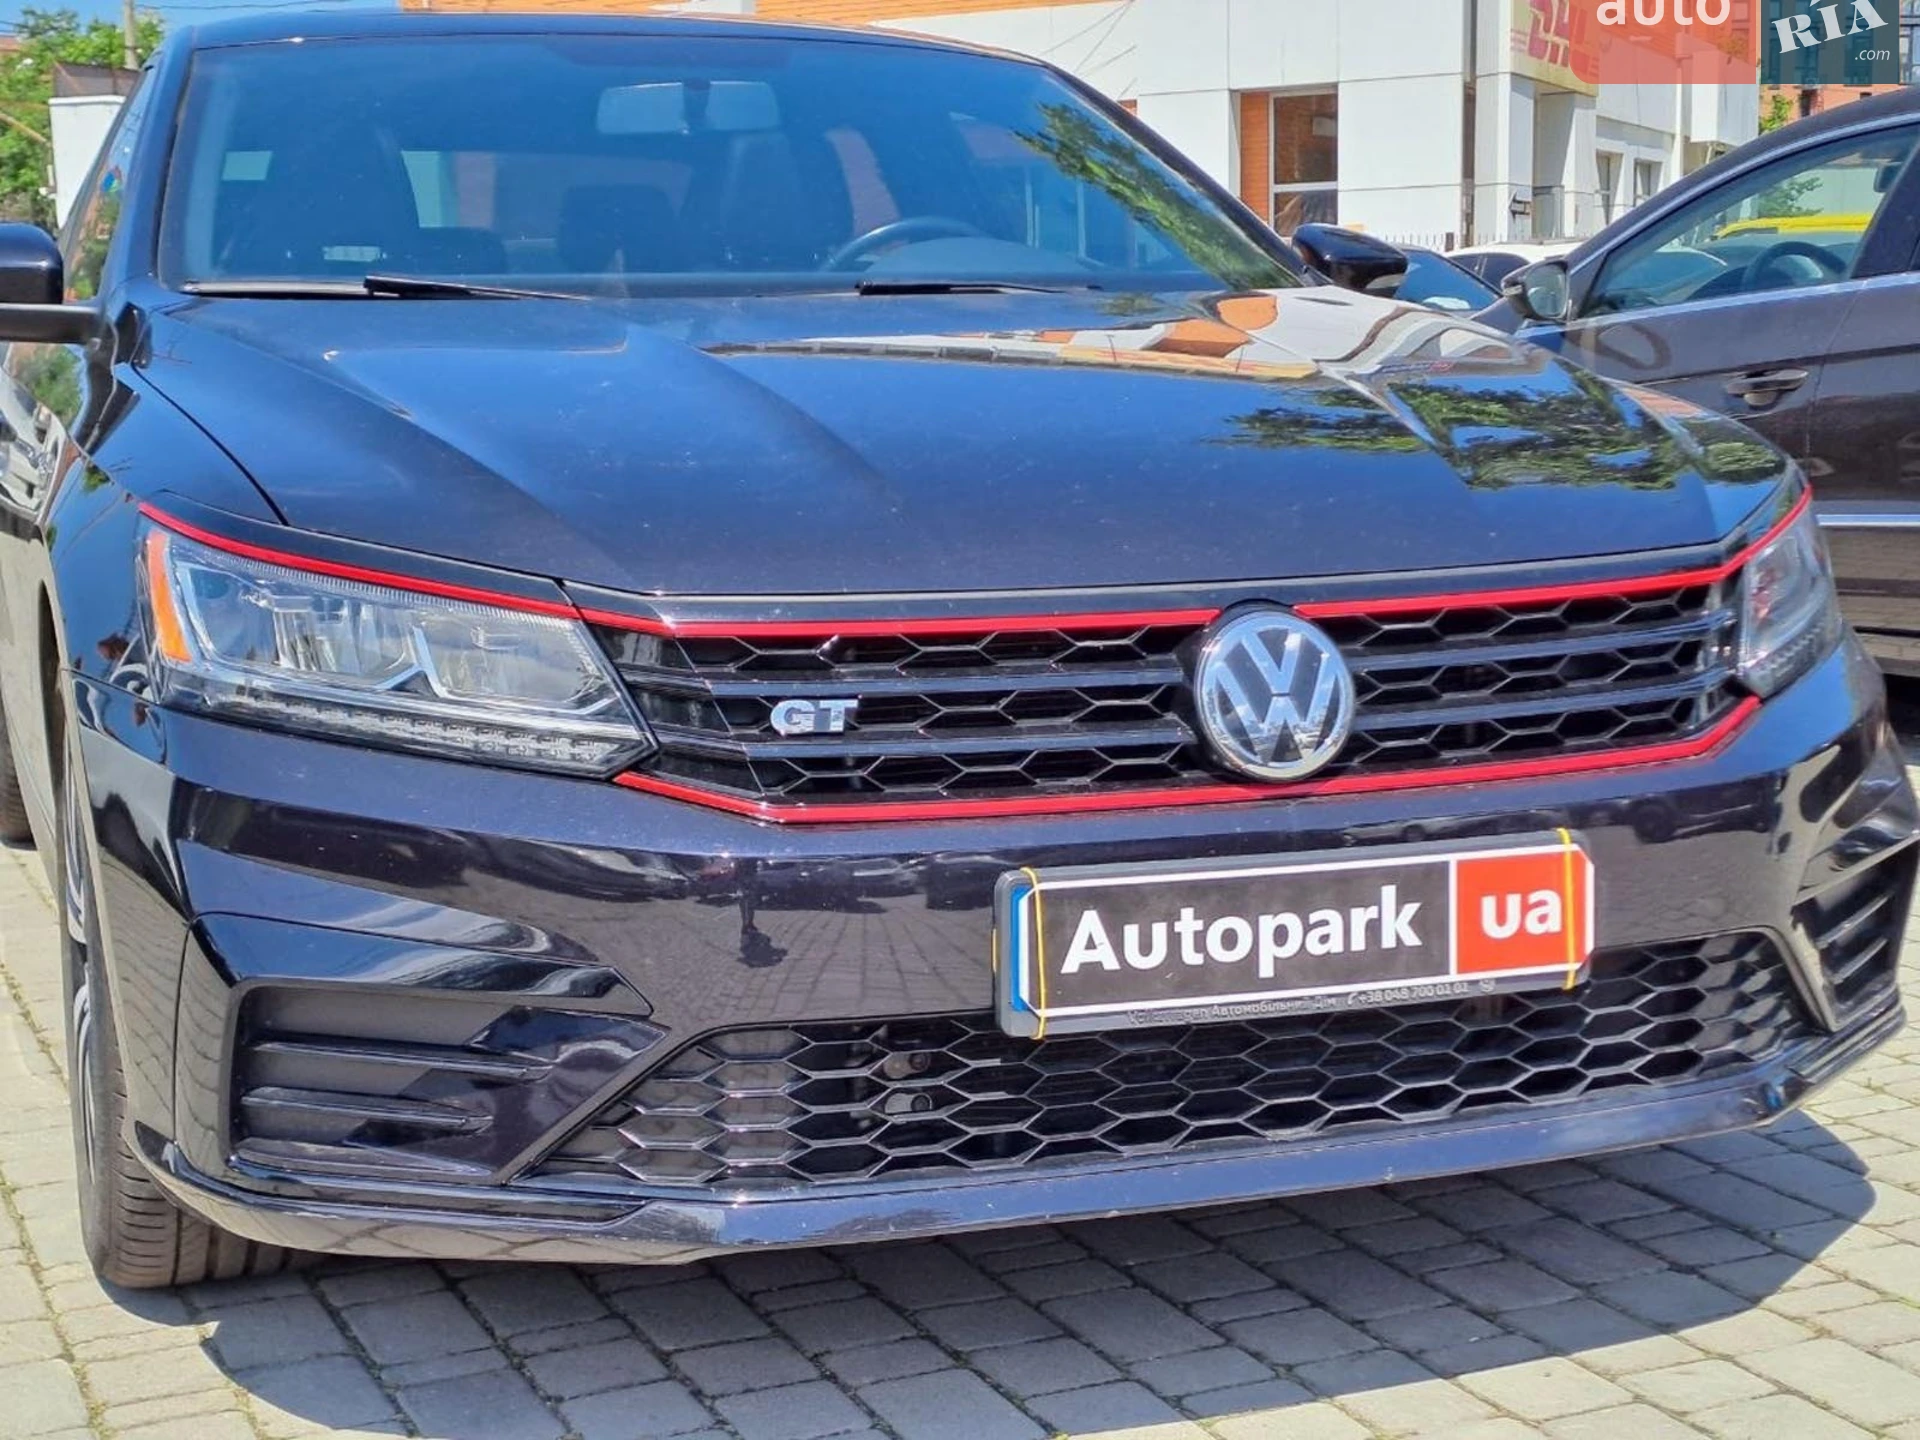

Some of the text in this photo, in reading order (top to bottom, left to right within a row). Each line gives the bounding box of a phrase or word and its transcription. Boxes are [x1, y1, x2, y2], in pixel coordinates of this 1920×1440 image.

[770, 699, 858, 735] GT
[1060, 885, 1562, 978] Autopark ua
[1128, 1008, 1208, 1026] Volagen
[1211, 997, 1311, 1018] Автомобільни
[1412, 984, 1434, 998] 700
